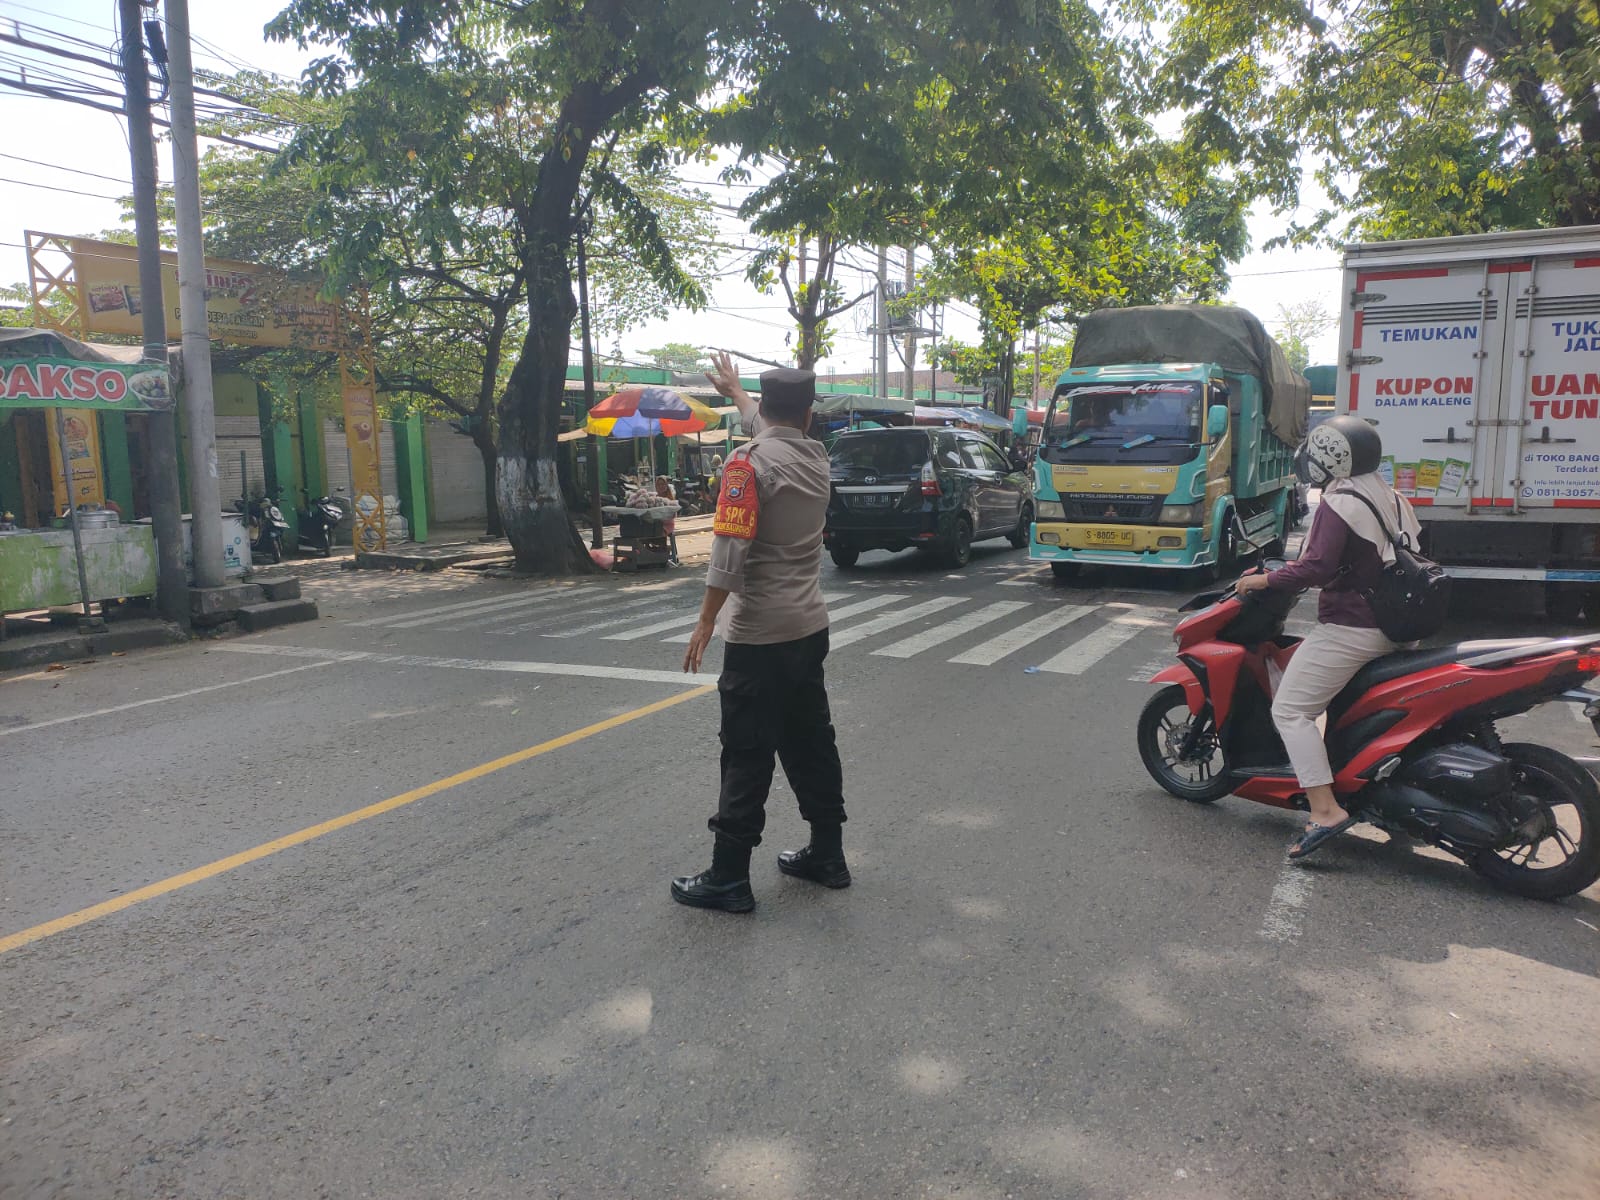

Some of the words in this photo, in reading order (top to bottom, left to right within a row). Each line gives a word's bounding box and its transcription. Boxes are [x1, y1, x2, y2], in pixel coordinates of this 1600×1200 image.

[1380, 326, 1478, 342] TEMUKAN
[1552, 321, 1600, 336] TUK
[0, 364, 127, 401] AKSO
[1375, 377, 1474, 395] KUPON
[1531, 373, 1600, 396] UAN
[1375, 399, 1418, 407] DALAM
[1421, 397, 1472, 406] KALENG
[1529, 399, 1600, 420] TUN
[1524, 454, 1534, 462] di
[1536, 454, 1566, 462] TOKO
[1568, 454, 1600, 462] BANG
[1555, 465, 1599, 473] Terdekat
[1537, 489, 1600, 497] 0811-3057-
[726, 506, 746, 523] SPK
